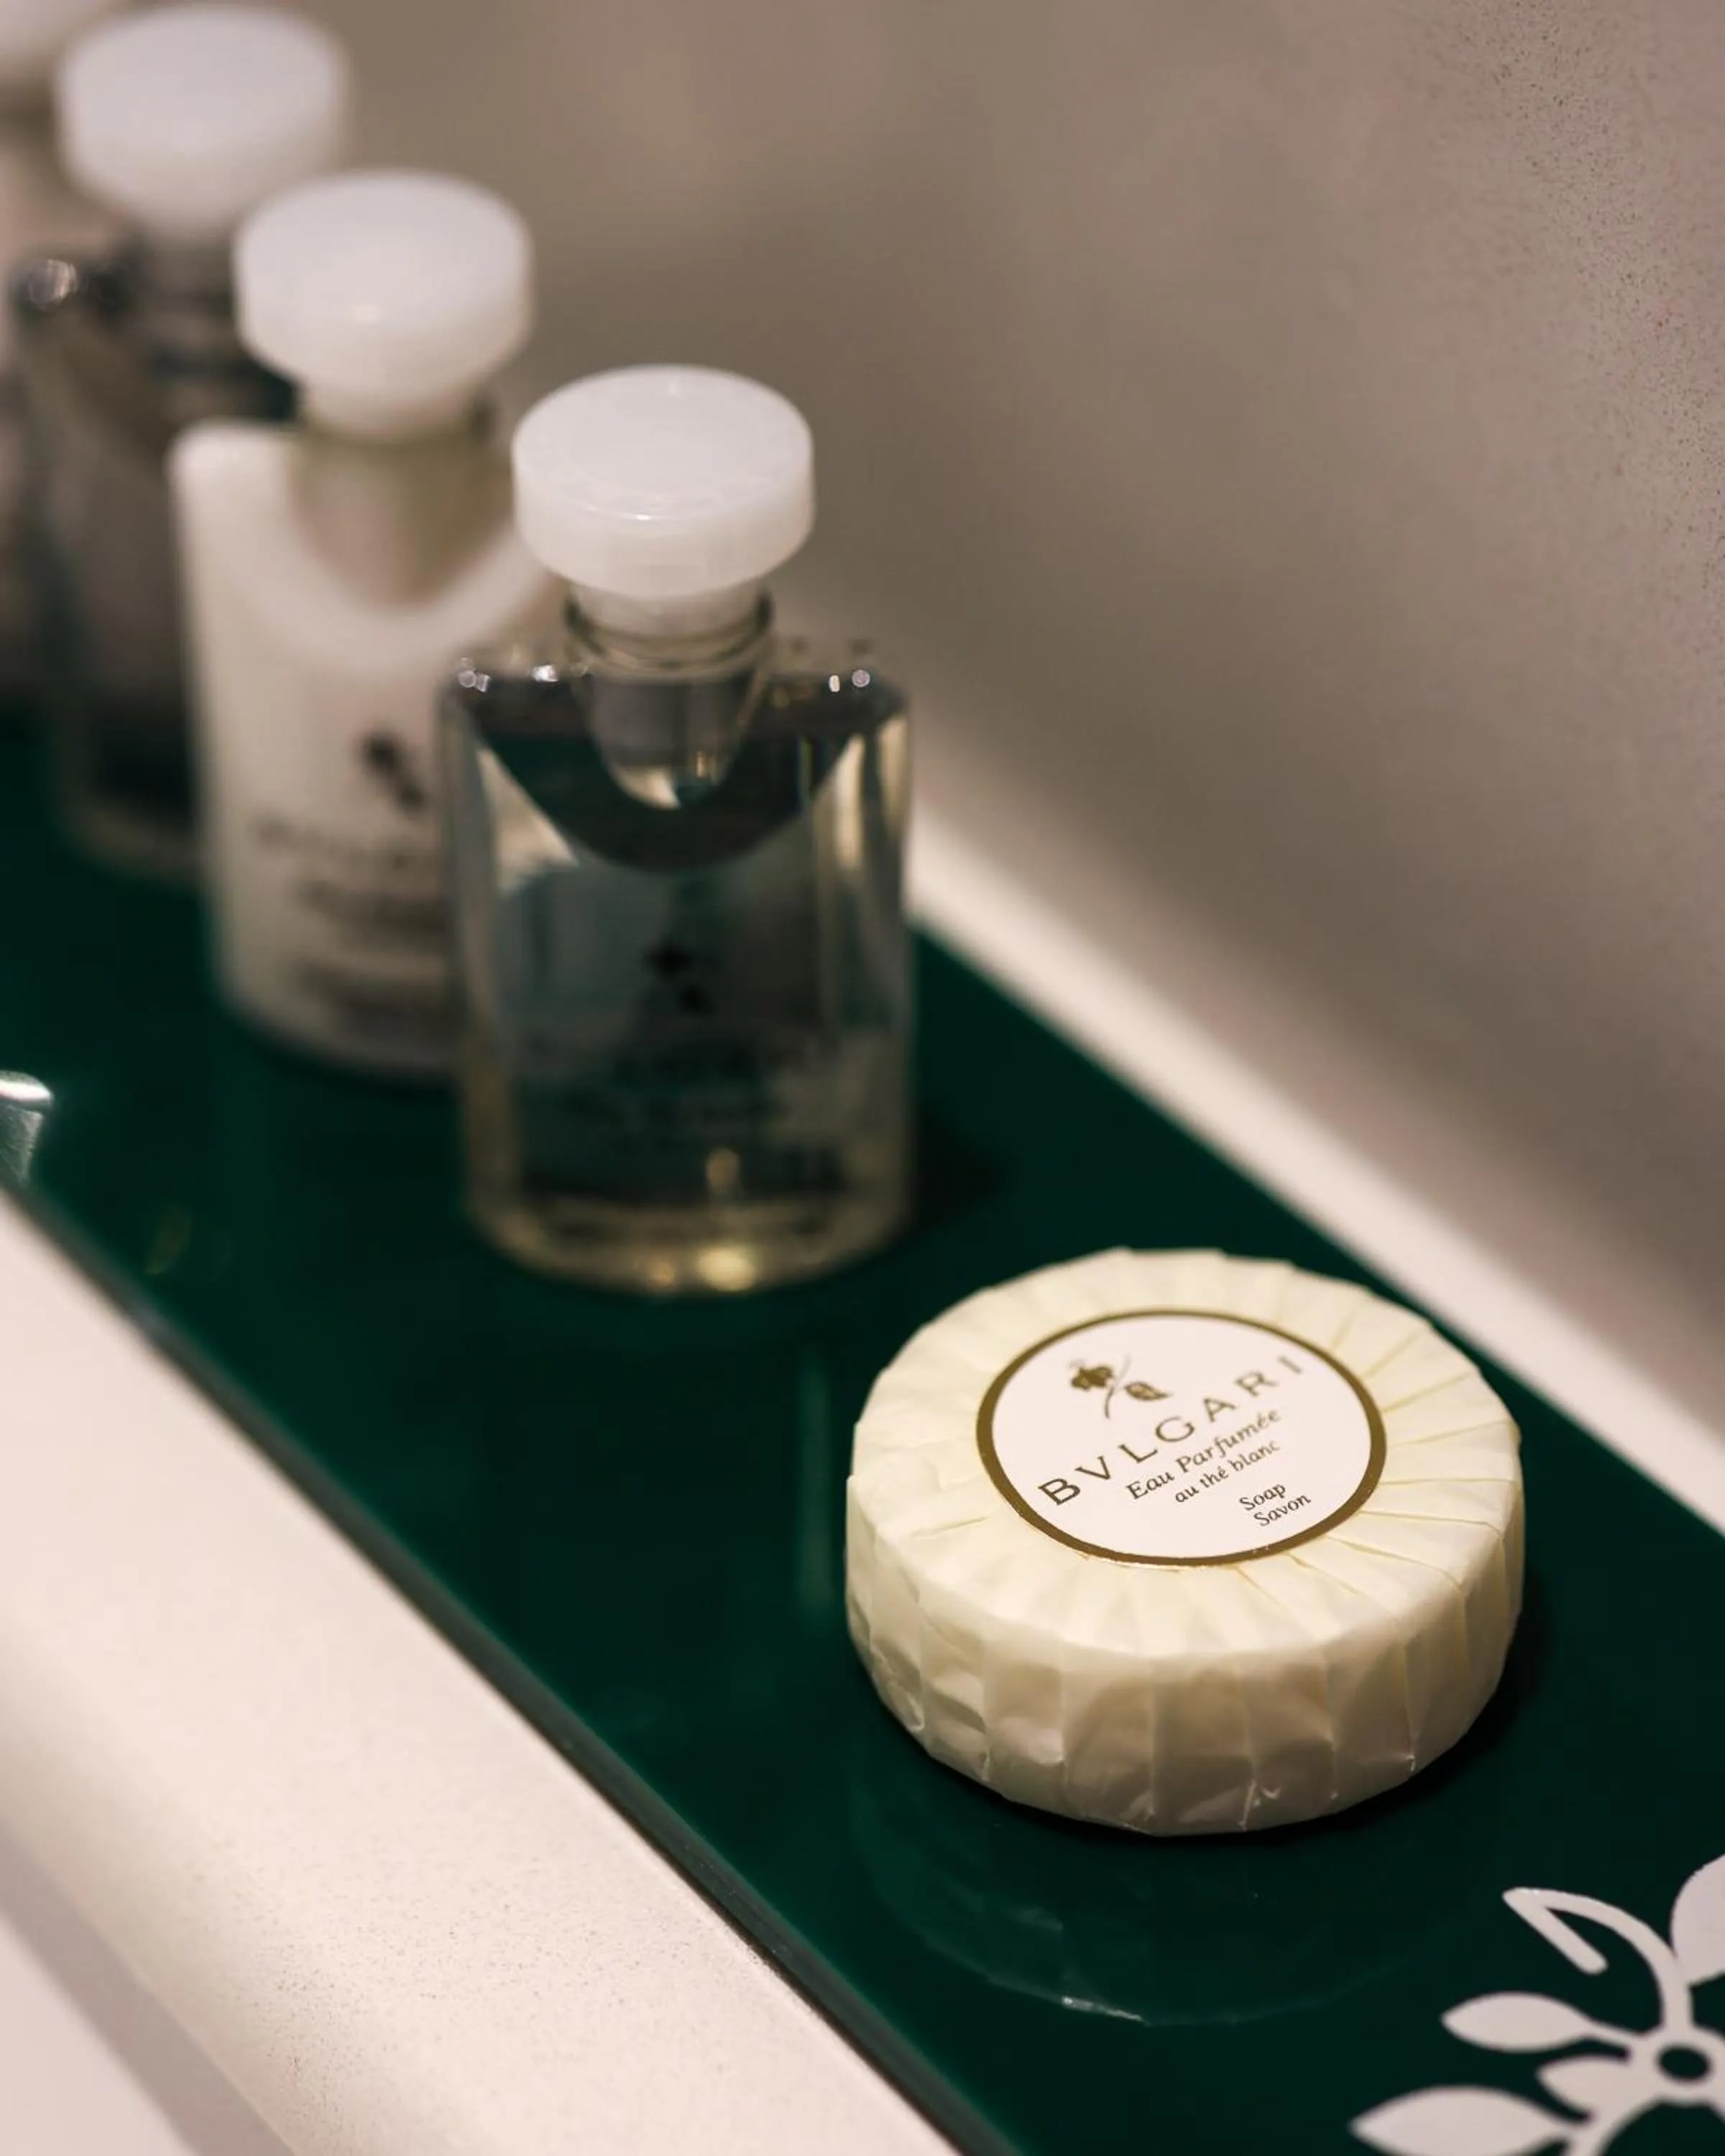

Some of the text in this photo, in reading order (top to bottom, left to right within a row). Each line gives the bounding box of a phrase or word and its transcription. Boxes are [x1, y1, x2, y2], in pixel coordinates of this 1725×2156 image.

[1038, 1356, 1302, 1505] BVLGARI
[1126, 1409, 1281, 1501] Eau Parfumée
[1175, 1441, 1280, 1503] au thé blanc
[1239, 1483, 1287, 1511] Soap
[1254, 1494, 1312, 1527] Savon
